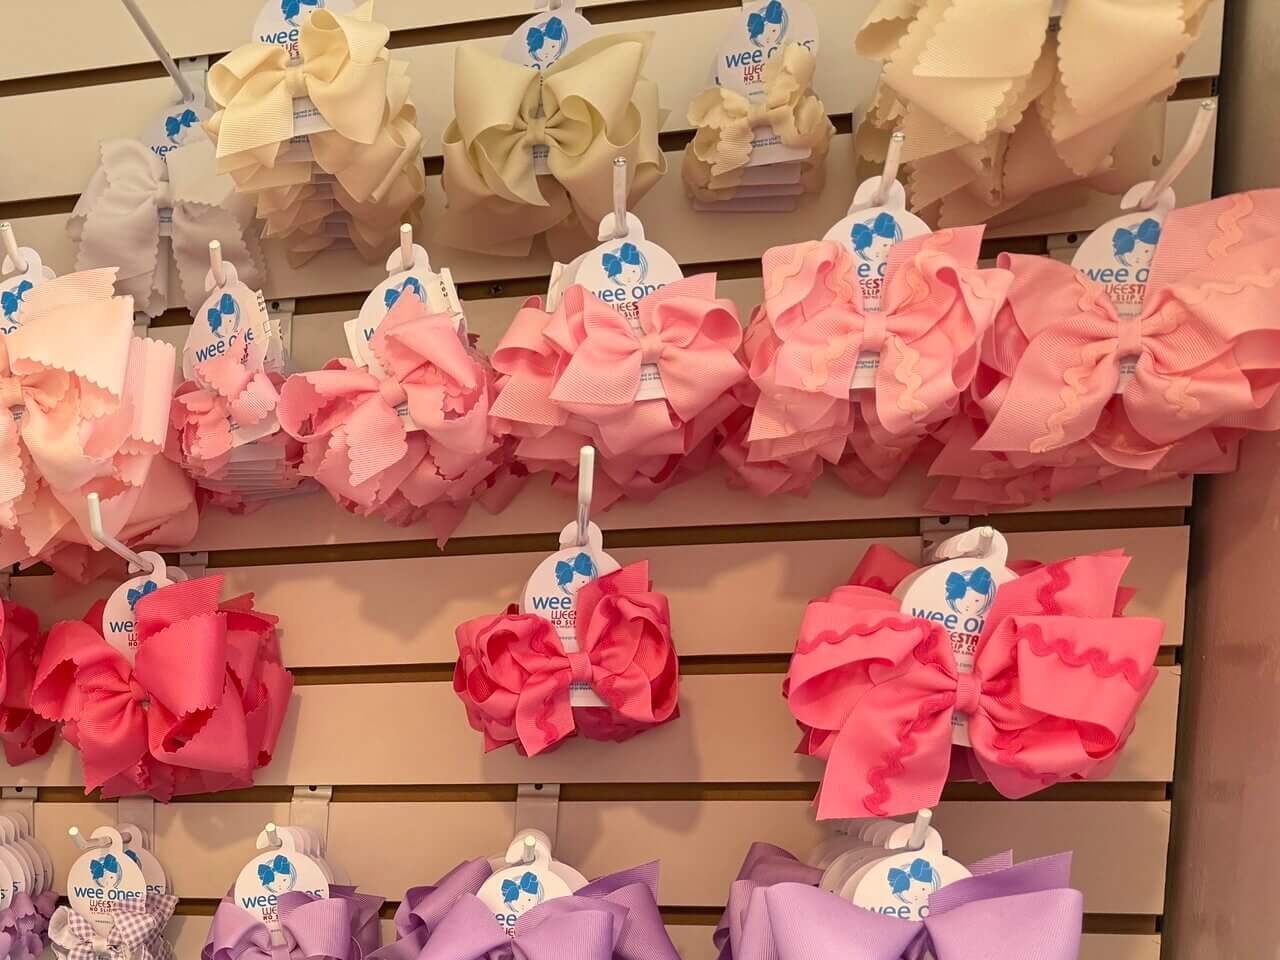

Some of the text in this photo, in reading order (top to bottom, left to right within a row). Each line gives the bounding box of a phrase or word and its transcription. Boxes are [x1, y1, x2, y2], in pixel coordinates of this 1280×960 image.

[261, 28, 299, 45] wee
[725, 49, 763, 68] wee
[195, 340, 225, 362] wee
[533, 597, 572, 610] wee
[74, 886, 103, 899] wee
[242, 894, 277, 909] wee
